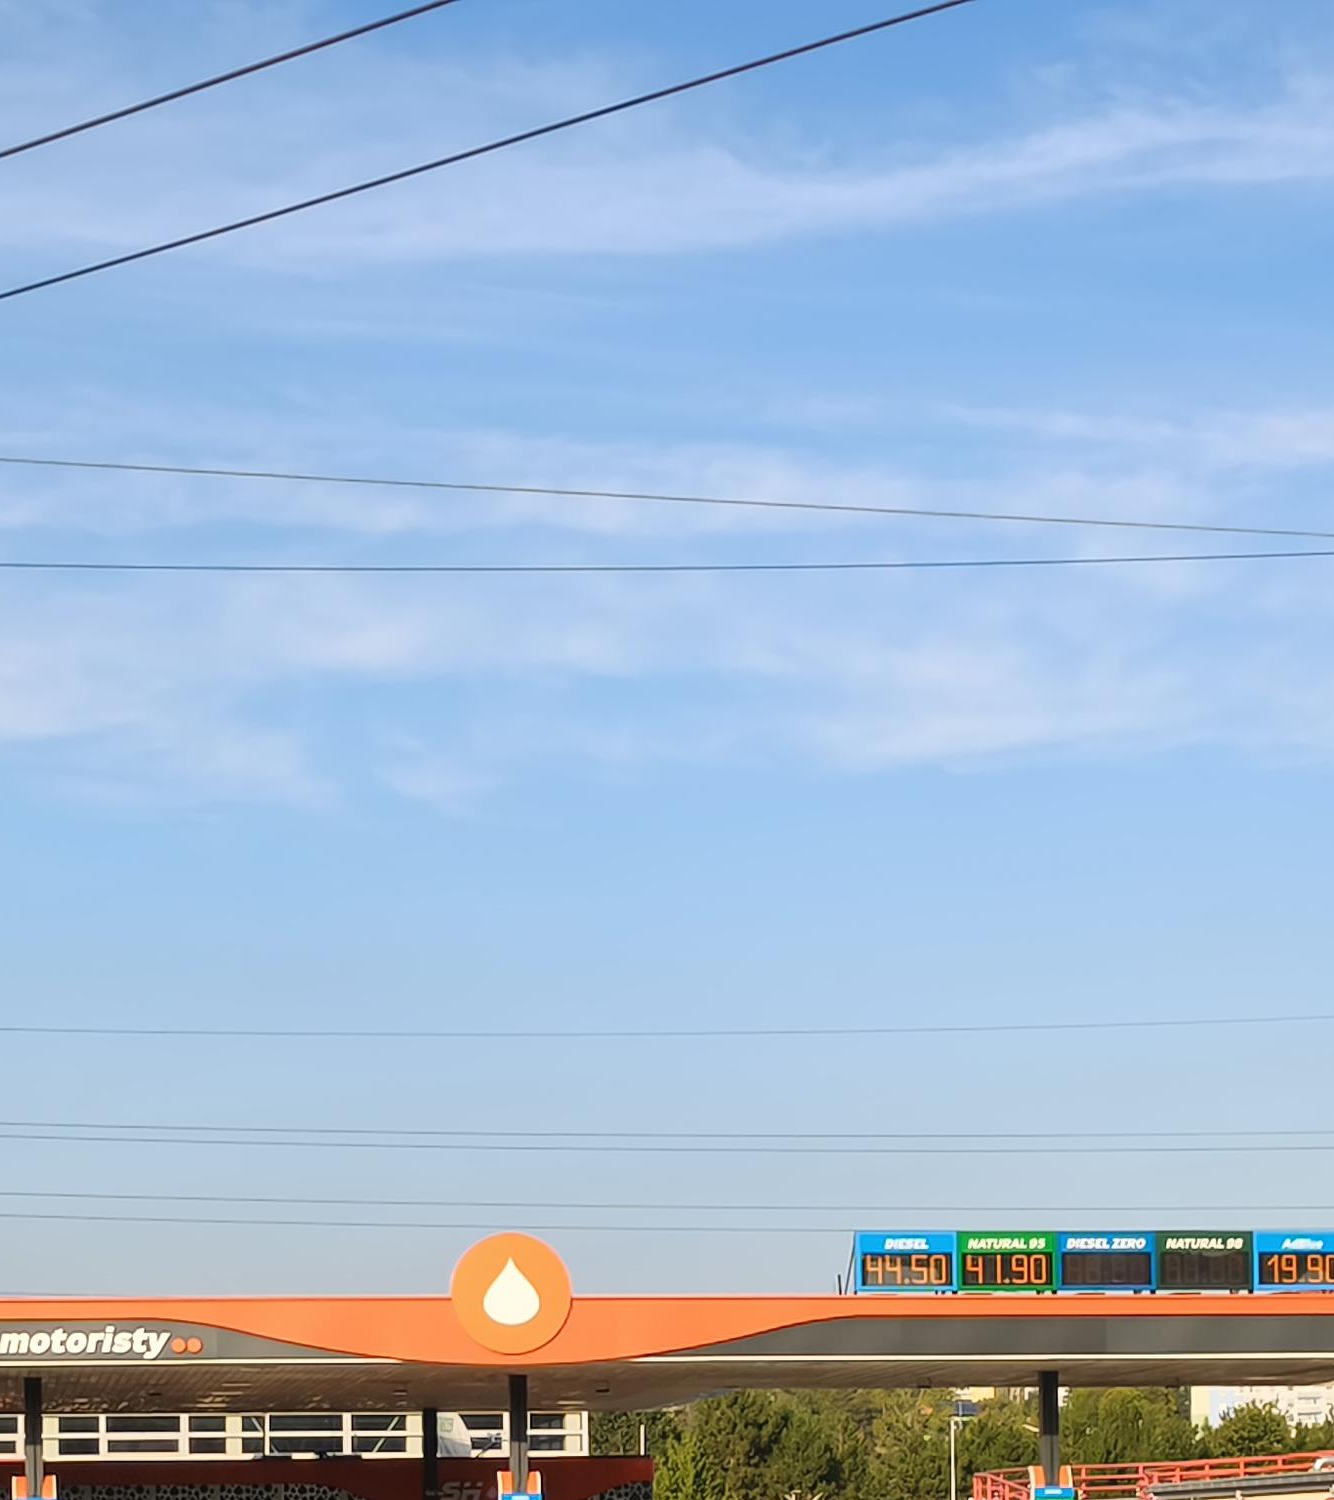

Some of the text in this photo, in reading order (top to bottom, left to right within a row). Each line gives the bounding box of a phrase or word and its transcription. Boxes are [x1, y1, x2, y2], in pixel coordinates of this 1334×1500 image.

[884, 1238, 929, 1250] DIESEL
[968, 1238, 1027, 1250] NATURAL
[1067, 1238, 1146, 1249] DIESEL ZERO
[1166, 1238, 1224, 1249] NATURAL
[865, 1254, 947, 1284] 44.50
[966, 1254, 1047, 1284] 41.90
